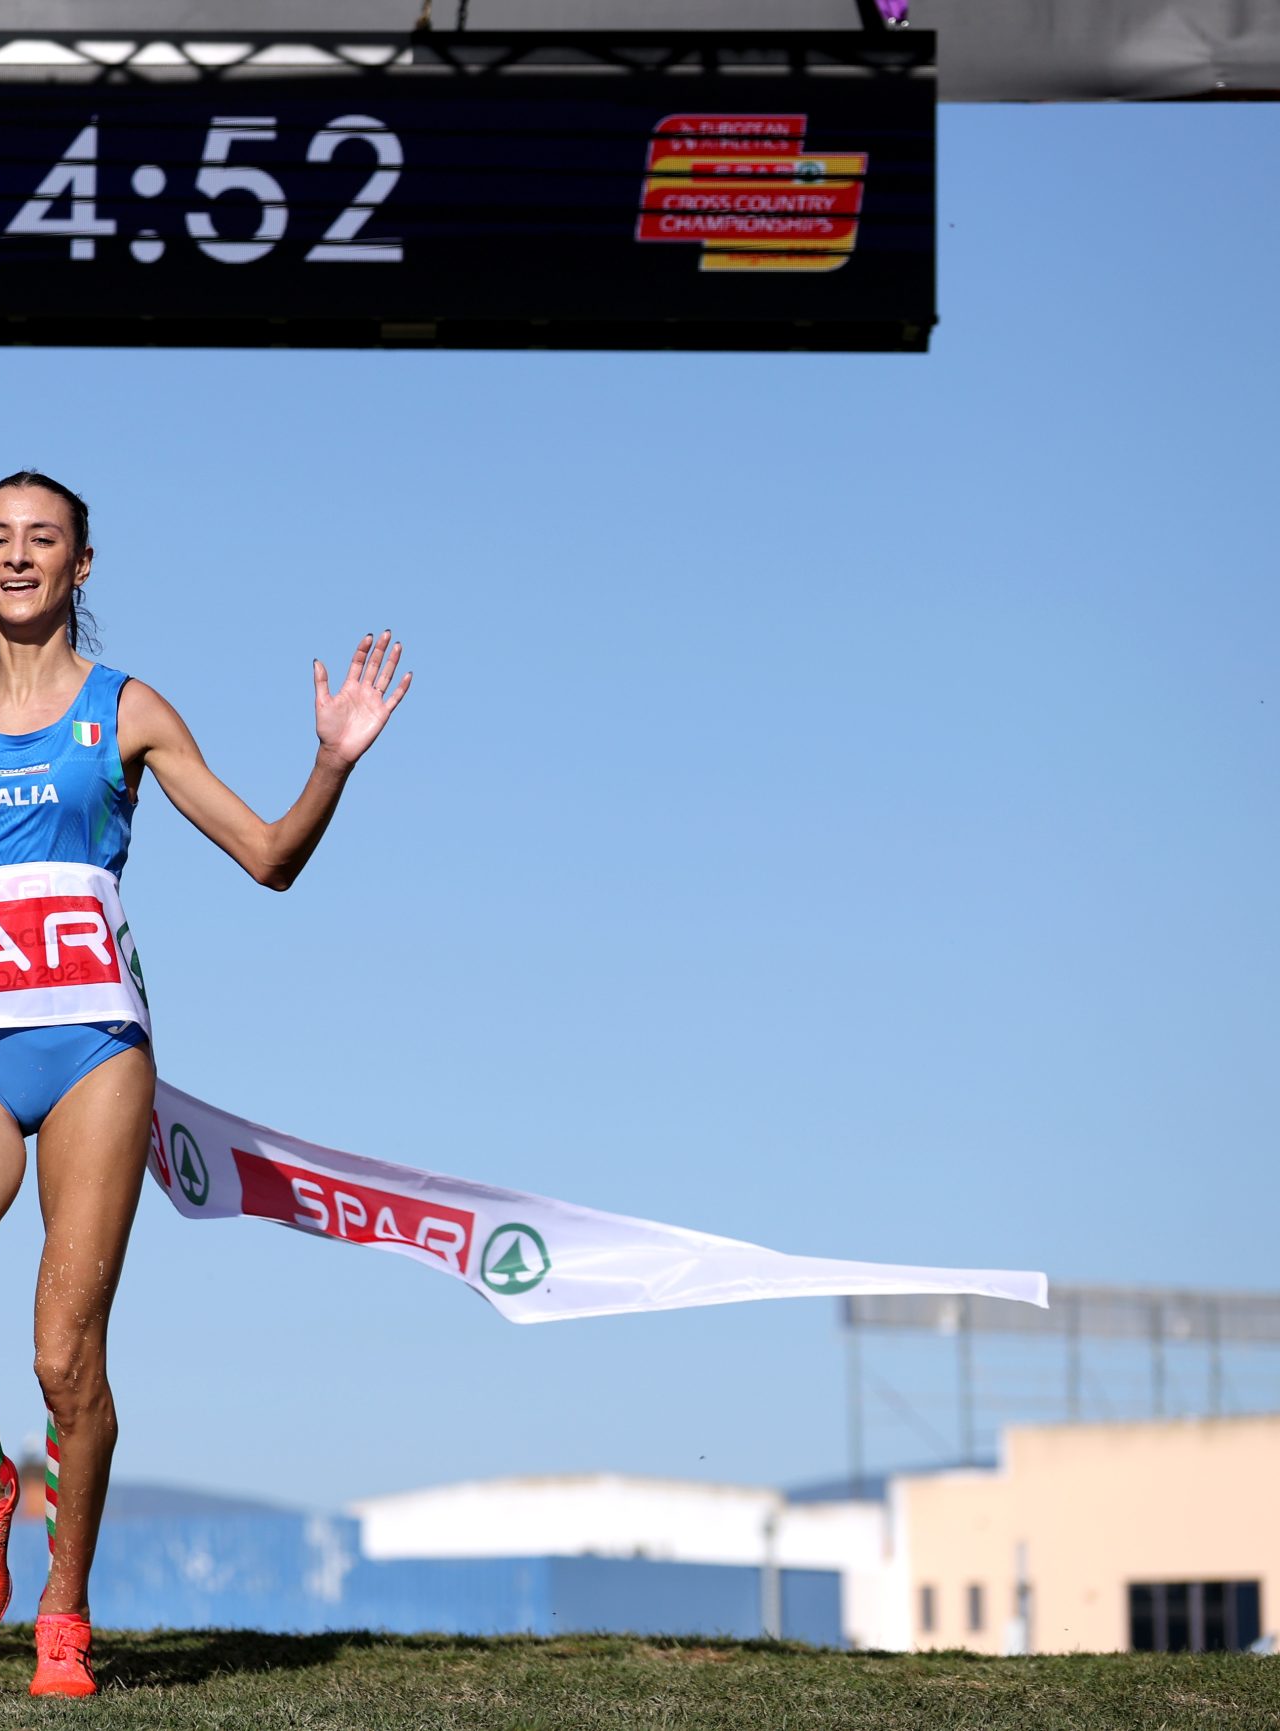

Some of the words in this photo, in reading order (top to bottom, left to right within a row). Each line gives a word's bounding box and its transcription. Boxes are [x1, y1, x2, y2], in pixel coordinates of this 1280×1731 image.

[663, 195, 730, 211] CROSS
[735, 195, 836, 212] COUNTRY
[659, 214, 834, 233] CHAMPIONSHIPS
[291, 1177, 468, 1270] SPAR
